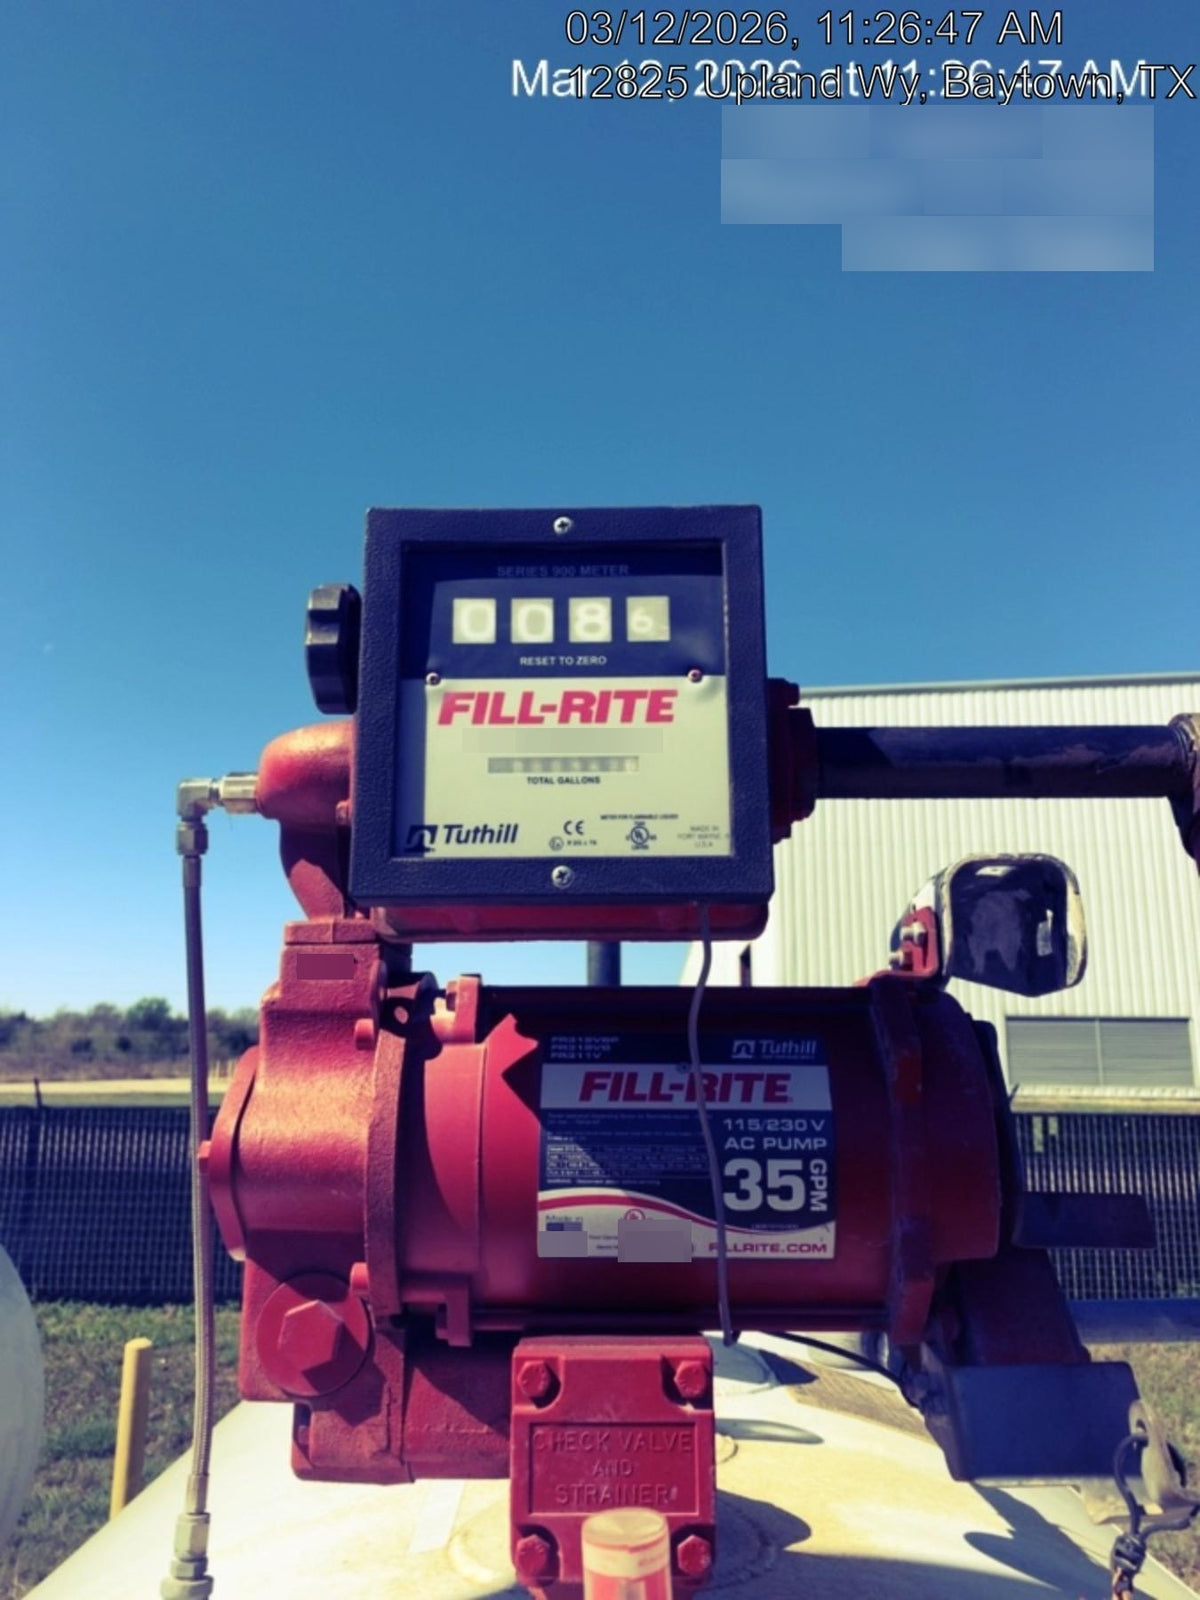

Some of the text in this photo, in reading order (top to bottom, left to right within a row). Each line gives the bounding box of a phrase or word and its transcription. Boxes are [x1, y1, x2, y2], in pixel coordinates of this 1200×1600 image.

[497, 564, 630, 577] SERIES 900 METER
[519, 655, 608, 666] RESET TO ZERO
[438, 689, 678, 726] FILL-RITE
[526, 776, 601, 785] TOTAL GALLONS
[442, 823, 519, 845] Tuthill
[759, 1039, 817, 1055] Tuthill
[579, 1072, 792, 1104] FILL-RITE
[723, 1118, 826, 1132] 115/230 V
[724, 1136, 828, 1151] AC PUMP
[723, 1157, 806, 1212] 35
[809, 1158, 829, 1212] GPM
[533, 1429, 694, 1454] CHECK VALVE
[591, 1458, 634, 1478] AND
[555, 1482, 669, 1506] STRAINER
